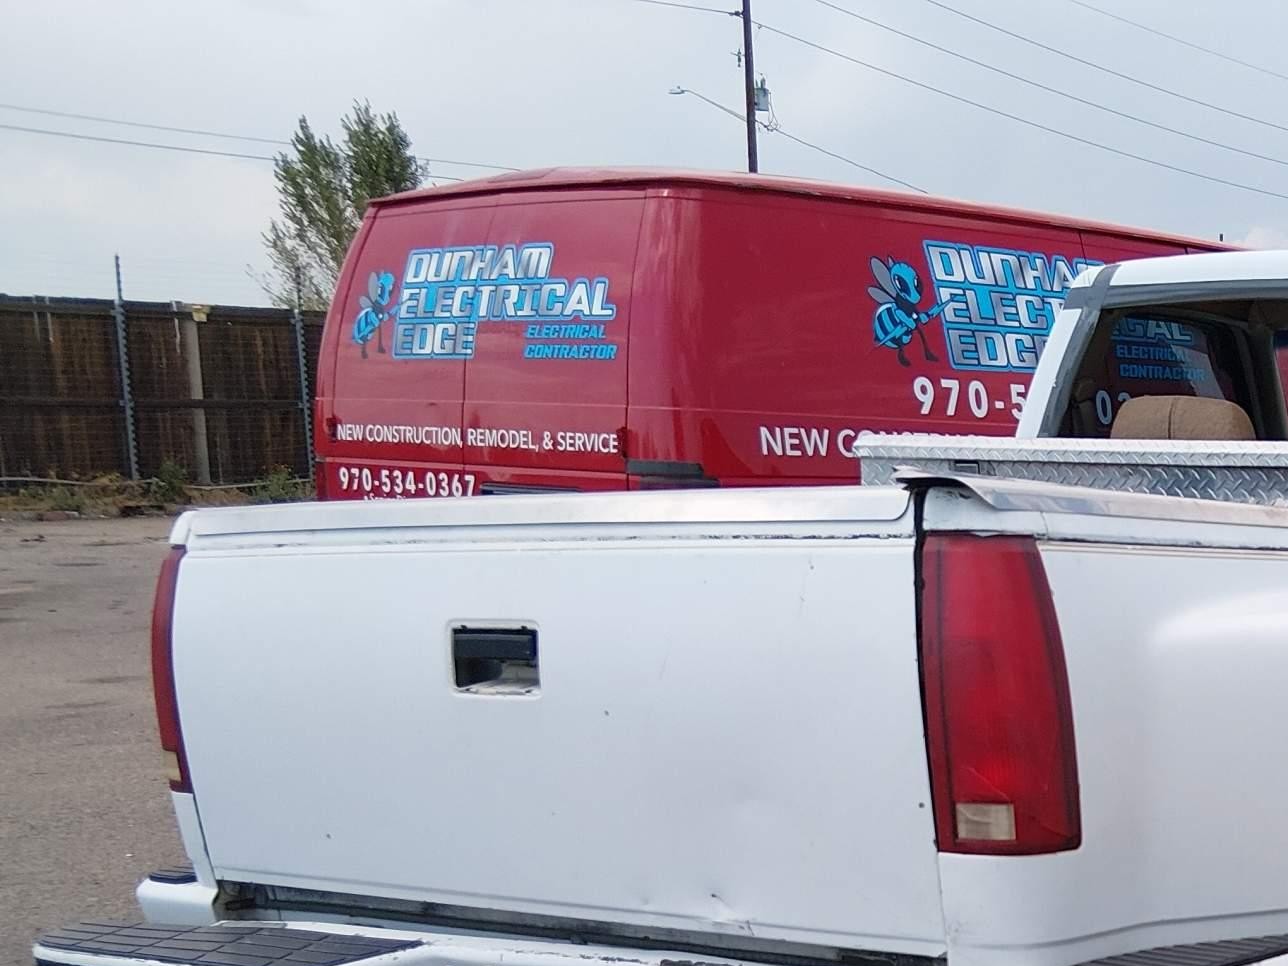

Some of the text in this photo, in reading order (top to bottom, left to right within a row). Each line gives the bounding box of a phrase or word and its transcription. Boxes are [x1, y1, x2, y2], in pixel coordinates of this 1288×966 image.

[405, 246, 553, 284] DUNHAM
[927, 246, 1098, 292] DUNHA
[400, 283, 615, 320] ELECTRICAL
[397, 321, 477, 355] EDGE
[526, 324, 606, 340] ELECTRICAL
[523, 344, 618, 361] CONTRACTOR
[337, 423, 619, 454] NEW CONSTRUCTION, REMODEL, & SERVICE
[759, 426, 830, 457] NEW
[338, 466, 476, 498] 970-534-0367
